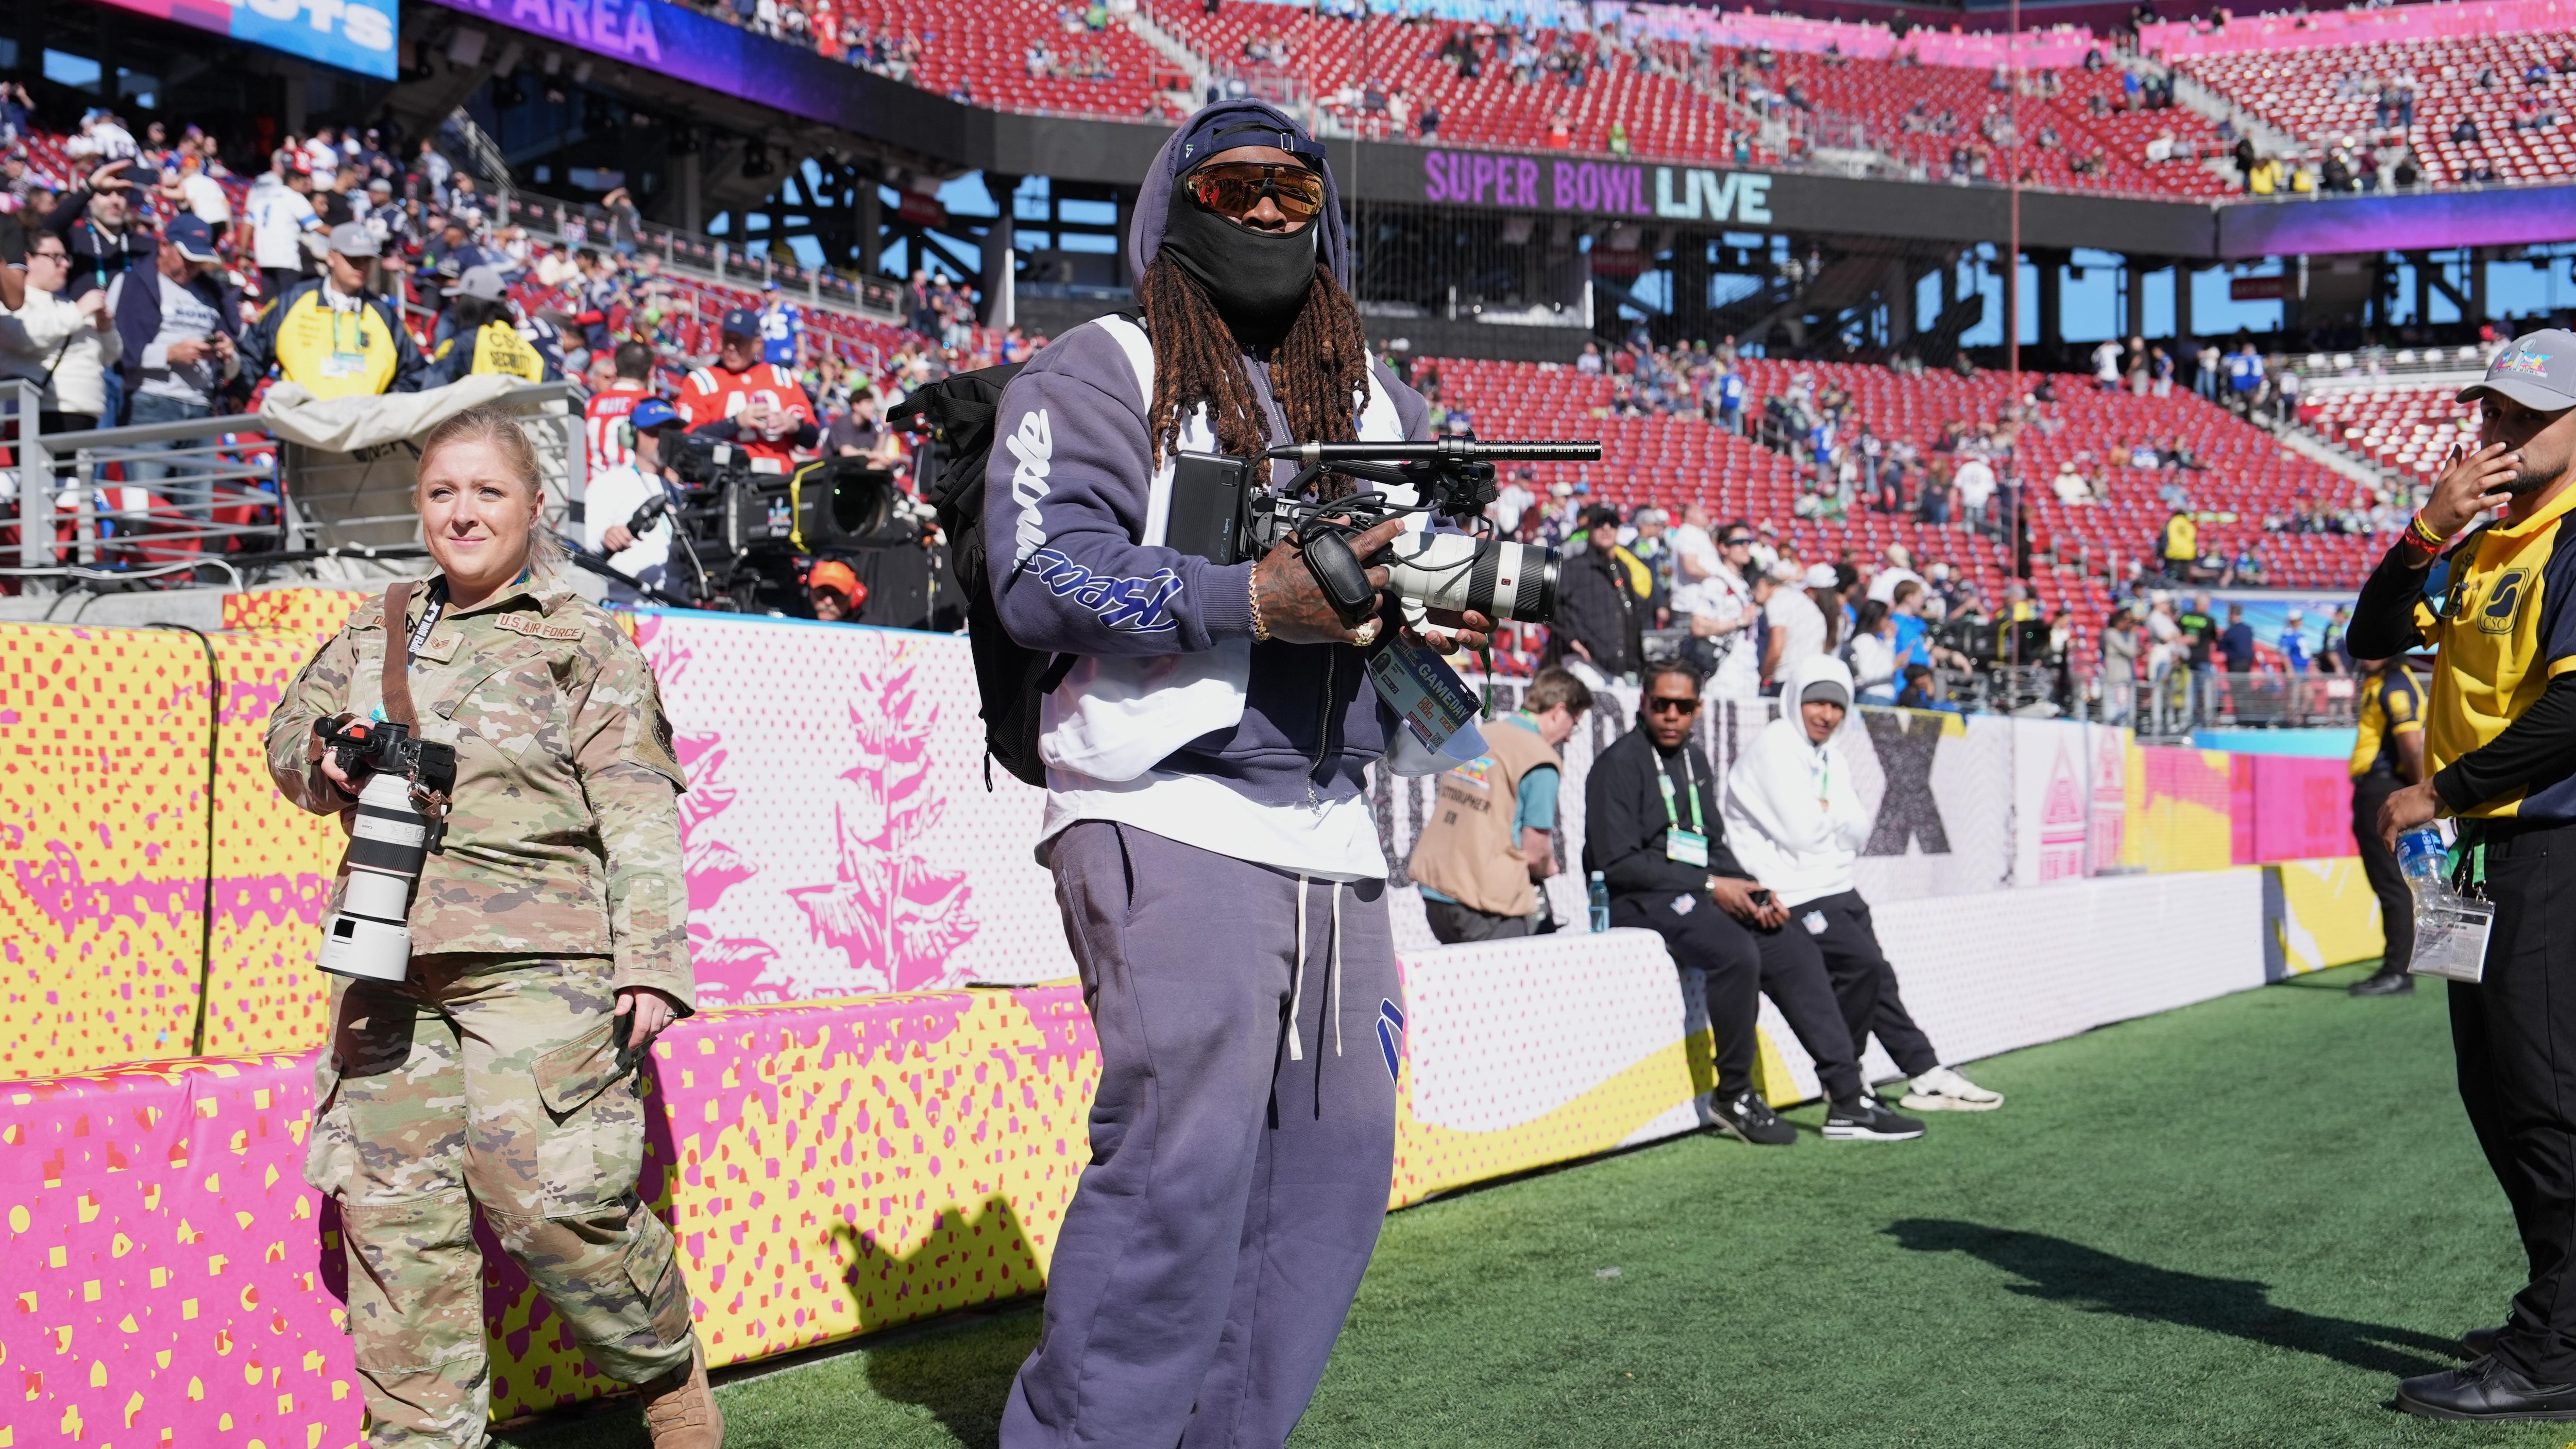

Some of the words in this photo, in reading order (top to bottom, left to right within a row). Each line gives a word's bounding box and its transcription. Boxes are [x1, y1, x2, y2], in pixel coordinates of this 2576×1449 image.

[1425, 151, 1539, 206] SUPER
[1553, 161, 1651, 215] BOWL
[1655, 166, 1772, 224] LIVE
[409, 634, 425, 653] SUPER
[421, 620, 433, 638] BOWL
[427, 600, 441, 621] LX
[501, 615, 522, 630] U.S.
[522, 621, 540, 633] AIR
[542, 625, 580, 638] FORCE
[2483, 617, 2507, 629] CSC
[1418, 663, 1469, 720] GAMEDAY
